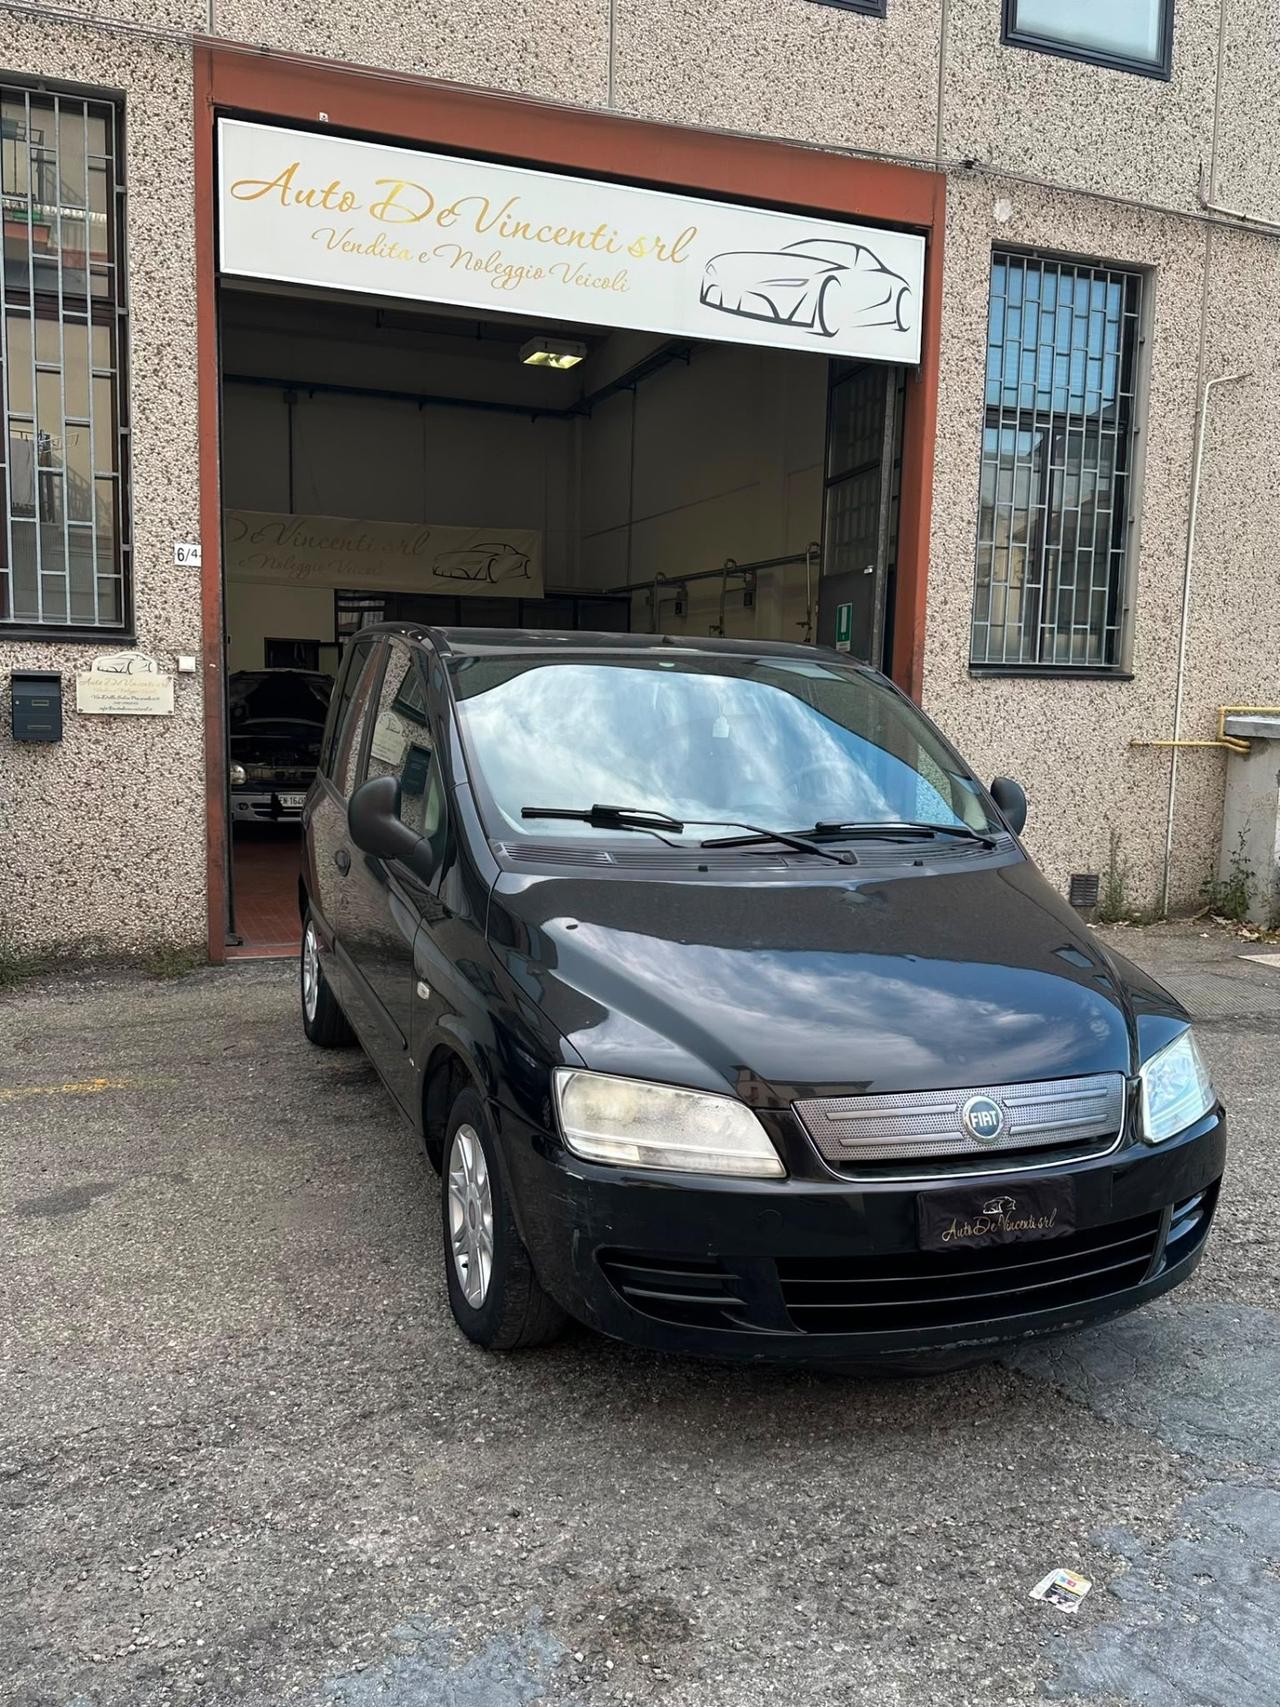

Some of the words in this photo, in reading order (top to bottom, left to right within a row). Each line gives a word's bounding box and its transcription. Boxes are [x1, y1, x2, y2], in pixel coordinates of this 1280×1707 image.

[230, 162, 360, 212] Auto
[627, 226, 698, 264] srl
[311, 227, 414, 262] Vendita
[418, 249, 432, 264] e
[433, 243, 546, 293] Noleggio
[548, 262, 631, 293] Veicoli
[177, 547, 198, 562] 6/4
[970, 1110, 997, 1128] FIAT
